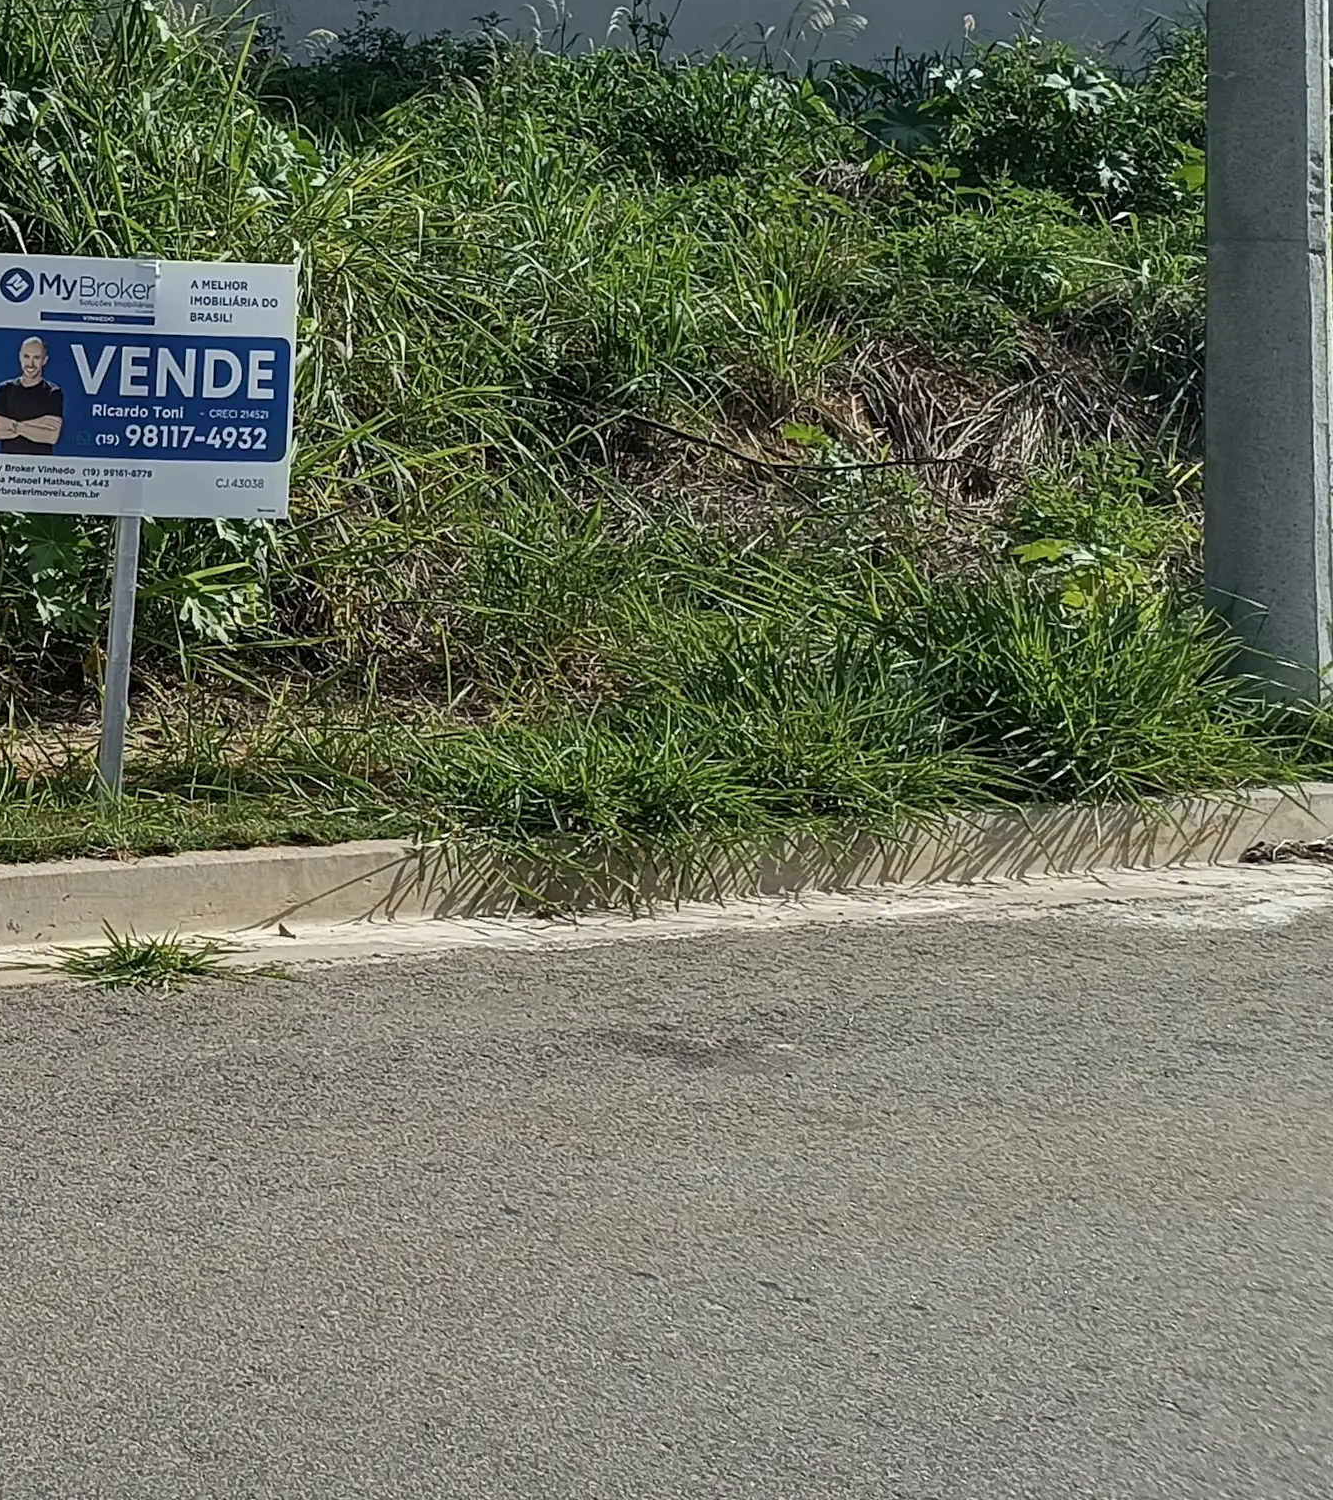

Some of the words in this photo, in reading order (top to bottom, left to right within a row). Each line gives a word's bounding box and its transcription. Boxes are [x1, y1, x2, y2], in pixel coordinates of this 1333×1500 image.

[190, 280, 199, 289] A
[201, 280, 248, 291] MELHOR
[190, 295, 259, 307] IMOBILIÁRIA
[261, 298, 278, 308] DO
[190, 312, 233, 323] BRASIL!
[70, 344, 276, 399] VENDE
[91, 404, 149, 418] Ricardo
[153, 406, 184, 419] Toni
[209, 409, 238, 419] CRECI
[240, 409, 269, 420] 214521
[95, 434, 120, 446] (19)
[125, 424, 268, 450] 98117-4932
[5, 464, 35, 473] Broker
[38, 465, 76, 475] Vinhedo
[8, 476, 41, 485] Manoel
[43, 478, 83, 487] Matheus,
